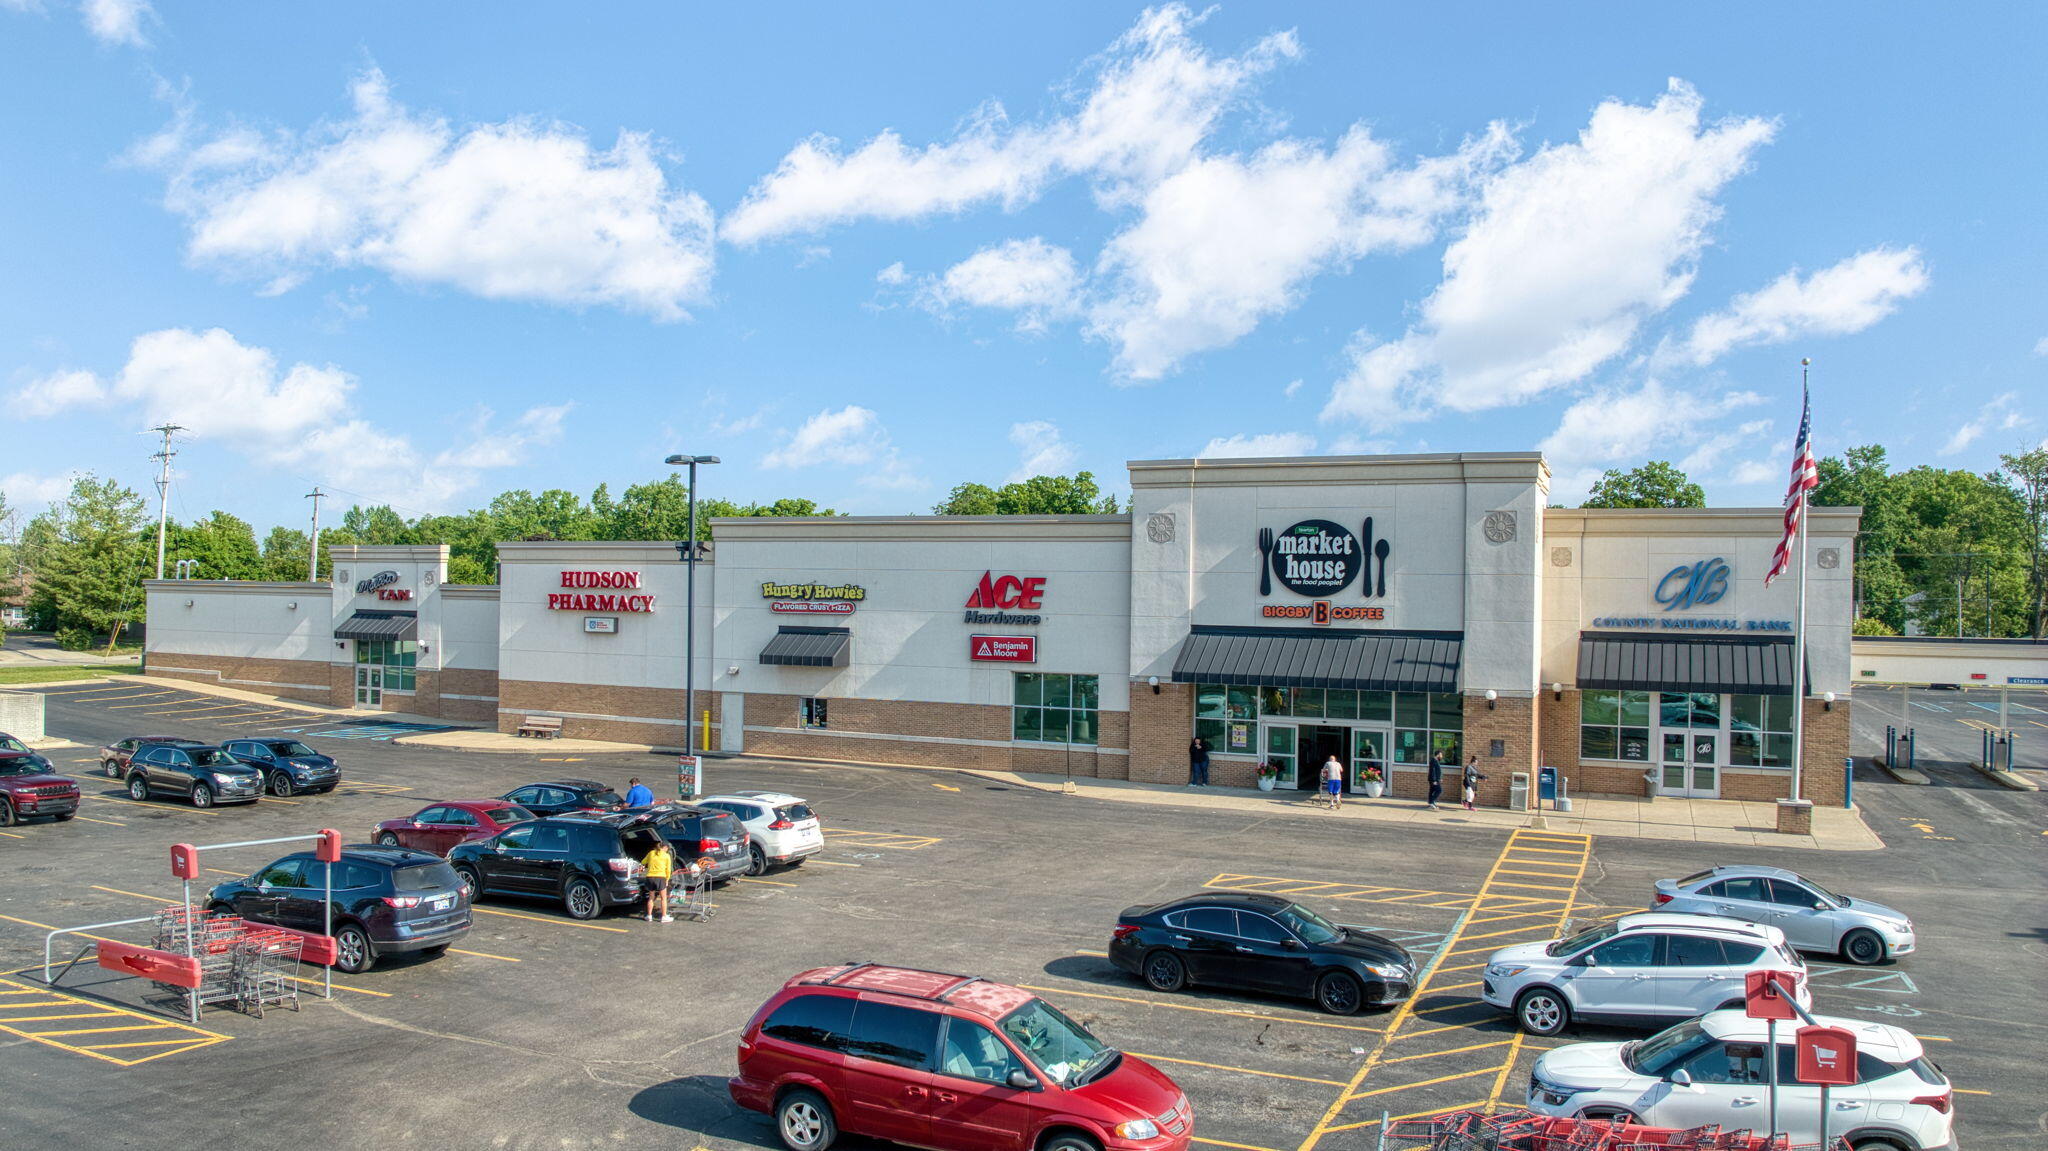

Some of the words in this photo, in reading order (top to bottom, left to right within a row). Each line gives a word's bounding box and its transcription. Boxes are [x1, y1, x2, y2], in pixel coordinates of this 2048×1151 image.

[1278, 530, 1353, 555] market
[1285, 554, 1346, 579] house
[560, 571, 640, 589] HUDSON
[964, 569, 1047, 609] ACE
[376, 589, 411, 601] TAN
[762, 582, 813, 600] Hungry
[814, 584, 865, 600] Howie's
[547, 593, 655, 612] PHARMACY
[774, 603, 808, 611] FLAVORED
[831, 604, 851, 612] PIZZA
[964, 610, 1041, 625] Hardware
[1262, 605, 1312, 618] BIGGBY
[1315, 602, 1328, 623] B
[1331, 607, 1384, 620] COFFEE
[1592, 617, 1656, 629] COUNTY
[1661, 618, 1742, 631] NATIONAL
[1745, 620, 1793, 632] BANK
[993, 641, 1028, 651] Benjamin
